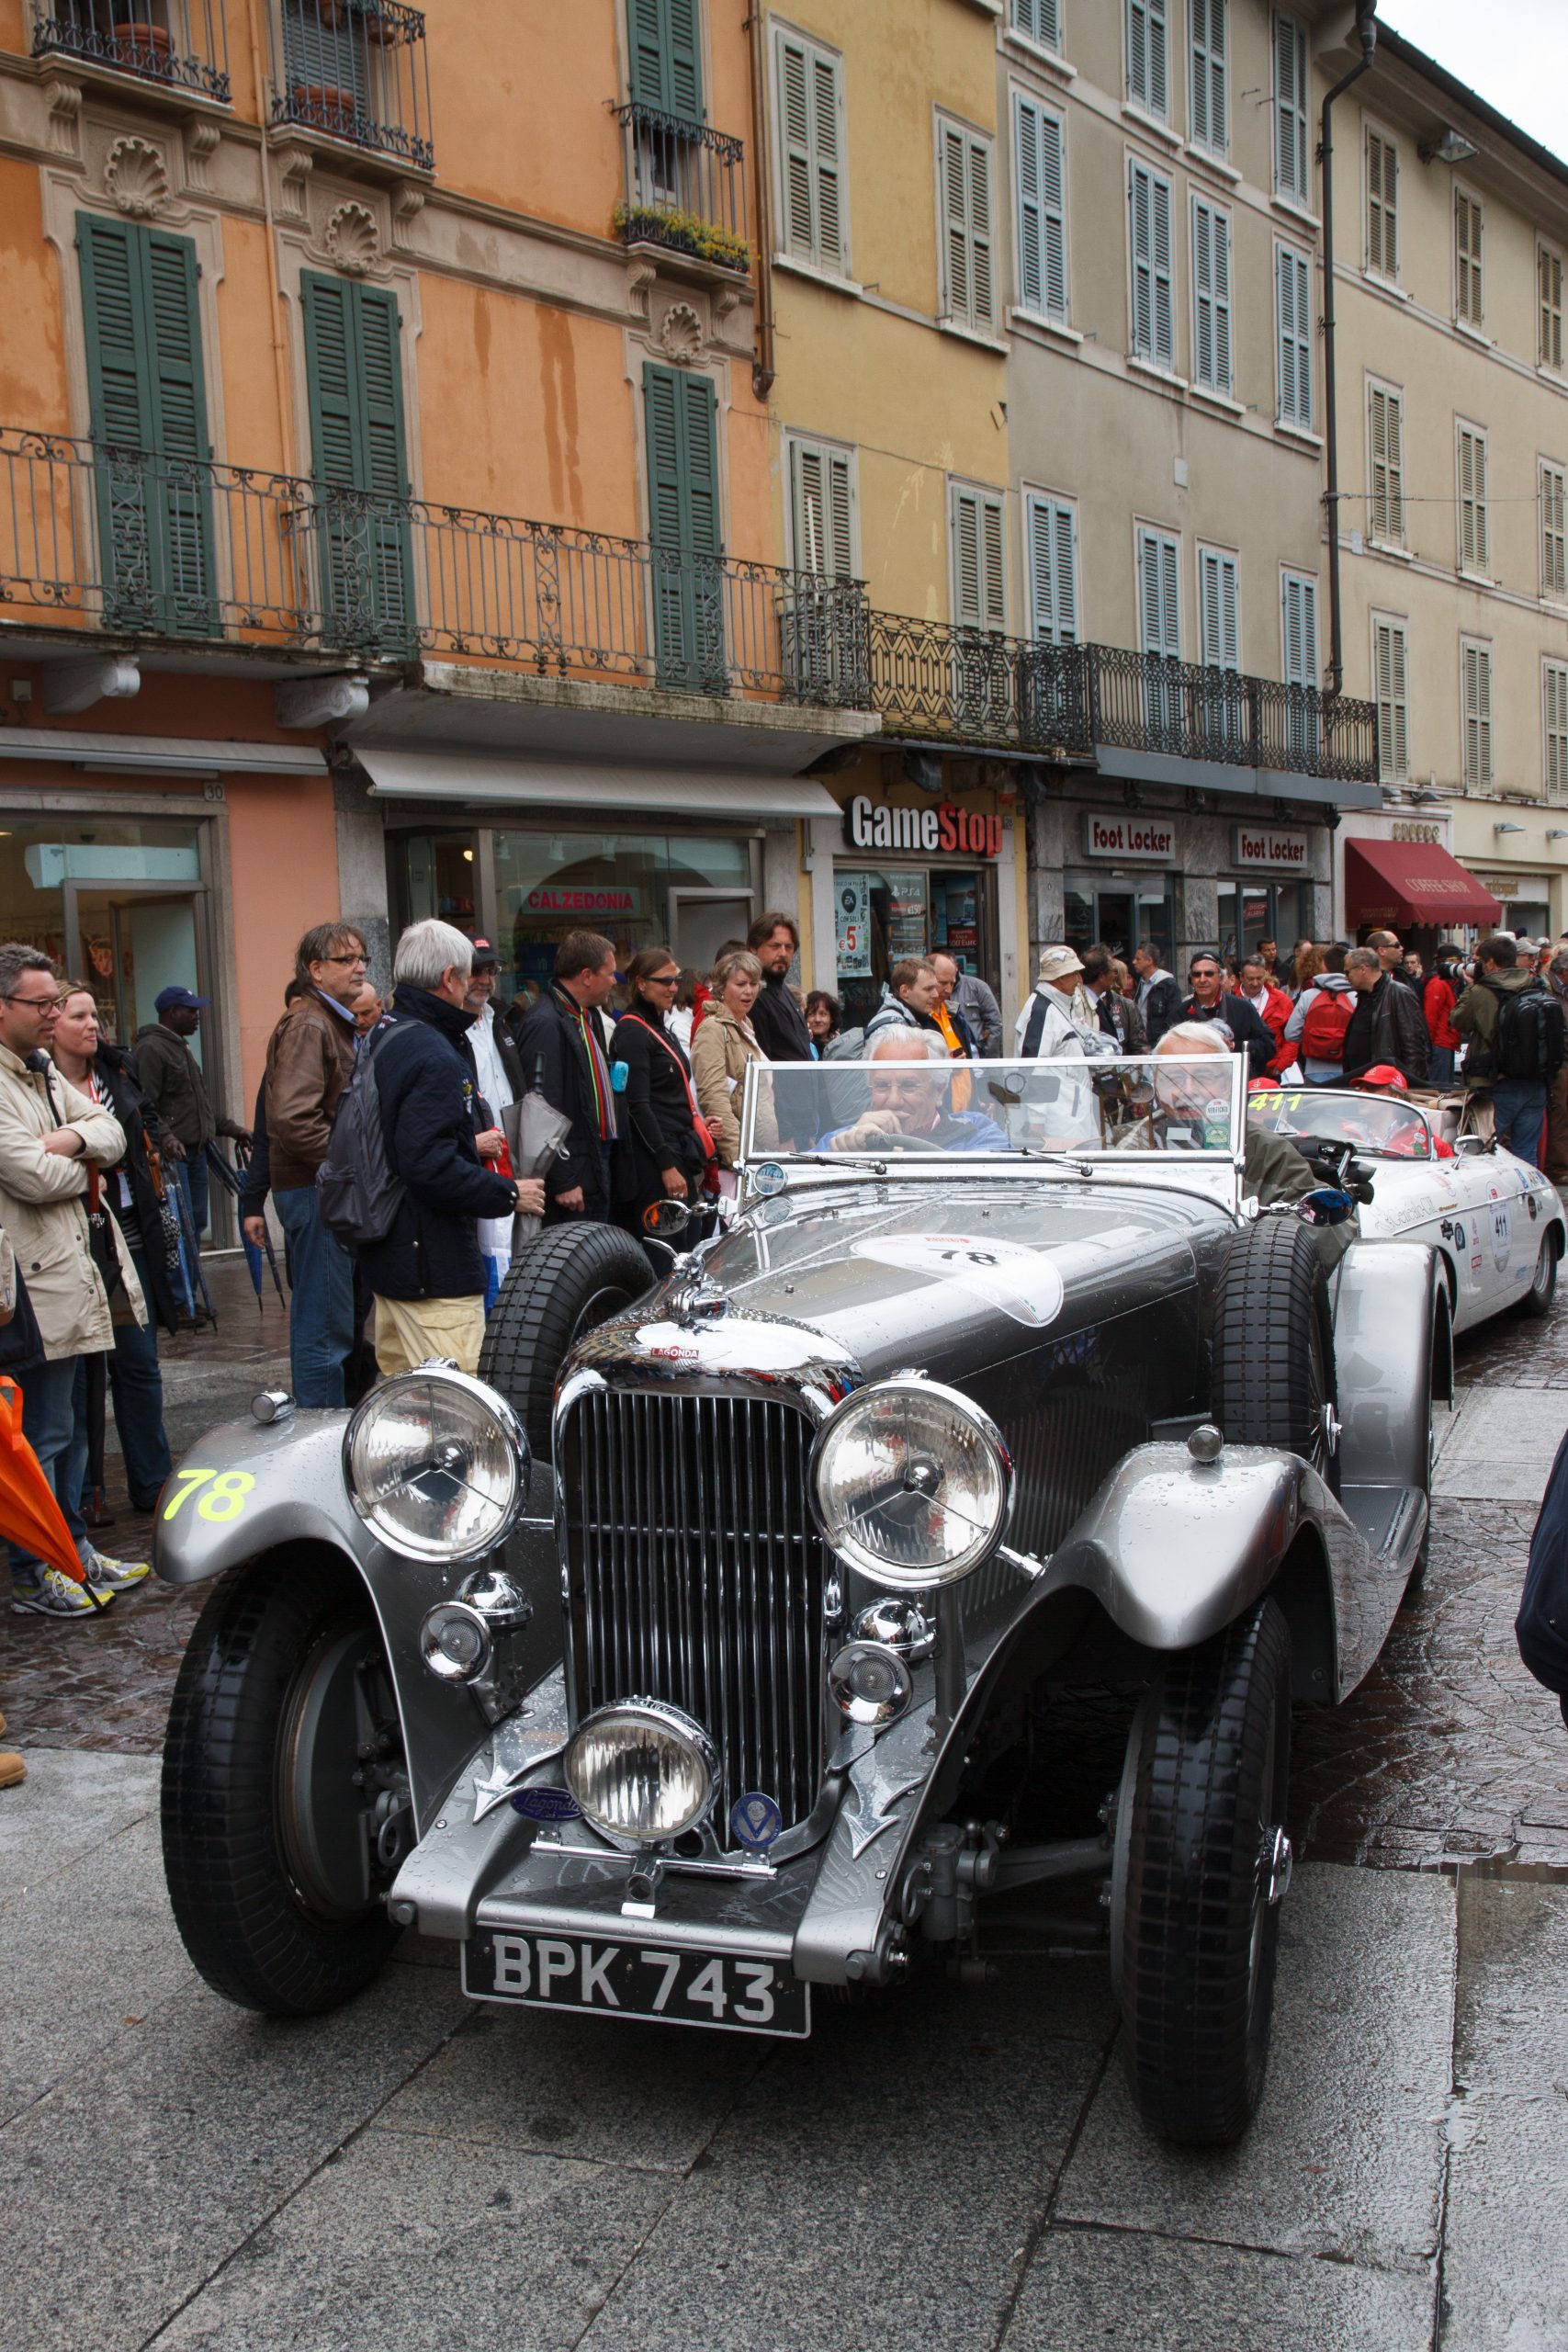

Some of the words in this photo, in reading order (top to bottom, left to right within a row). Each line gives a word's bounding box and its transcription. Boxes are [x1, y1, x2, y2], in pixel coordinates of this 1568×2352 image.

[208, 785, 223, 799] 30
[852, 795, 1002, 858] GameStop
[1093, 822, 1122, 849] Foot
[1128, 824, 1171, 853] Locker
[1242, 834, 1266, 859] Foot
[1269, 836, 1304, 862] Locker
[528, 891, 634, 910] CALZEDONIA
[901, 888, 920, 897] PS4
[1248, 1093, 1302, 1111] 411
[1495, 1215, 1507, 1238] 411
[927, 1248, 1000, 1266] 78
[651, 1347, 698, 1358] LAGONDA
[164, 1469, 255, 1521] 78
[493, 1935, 621, 2007] BPK
[640, 1951, 775, 2023] 743
